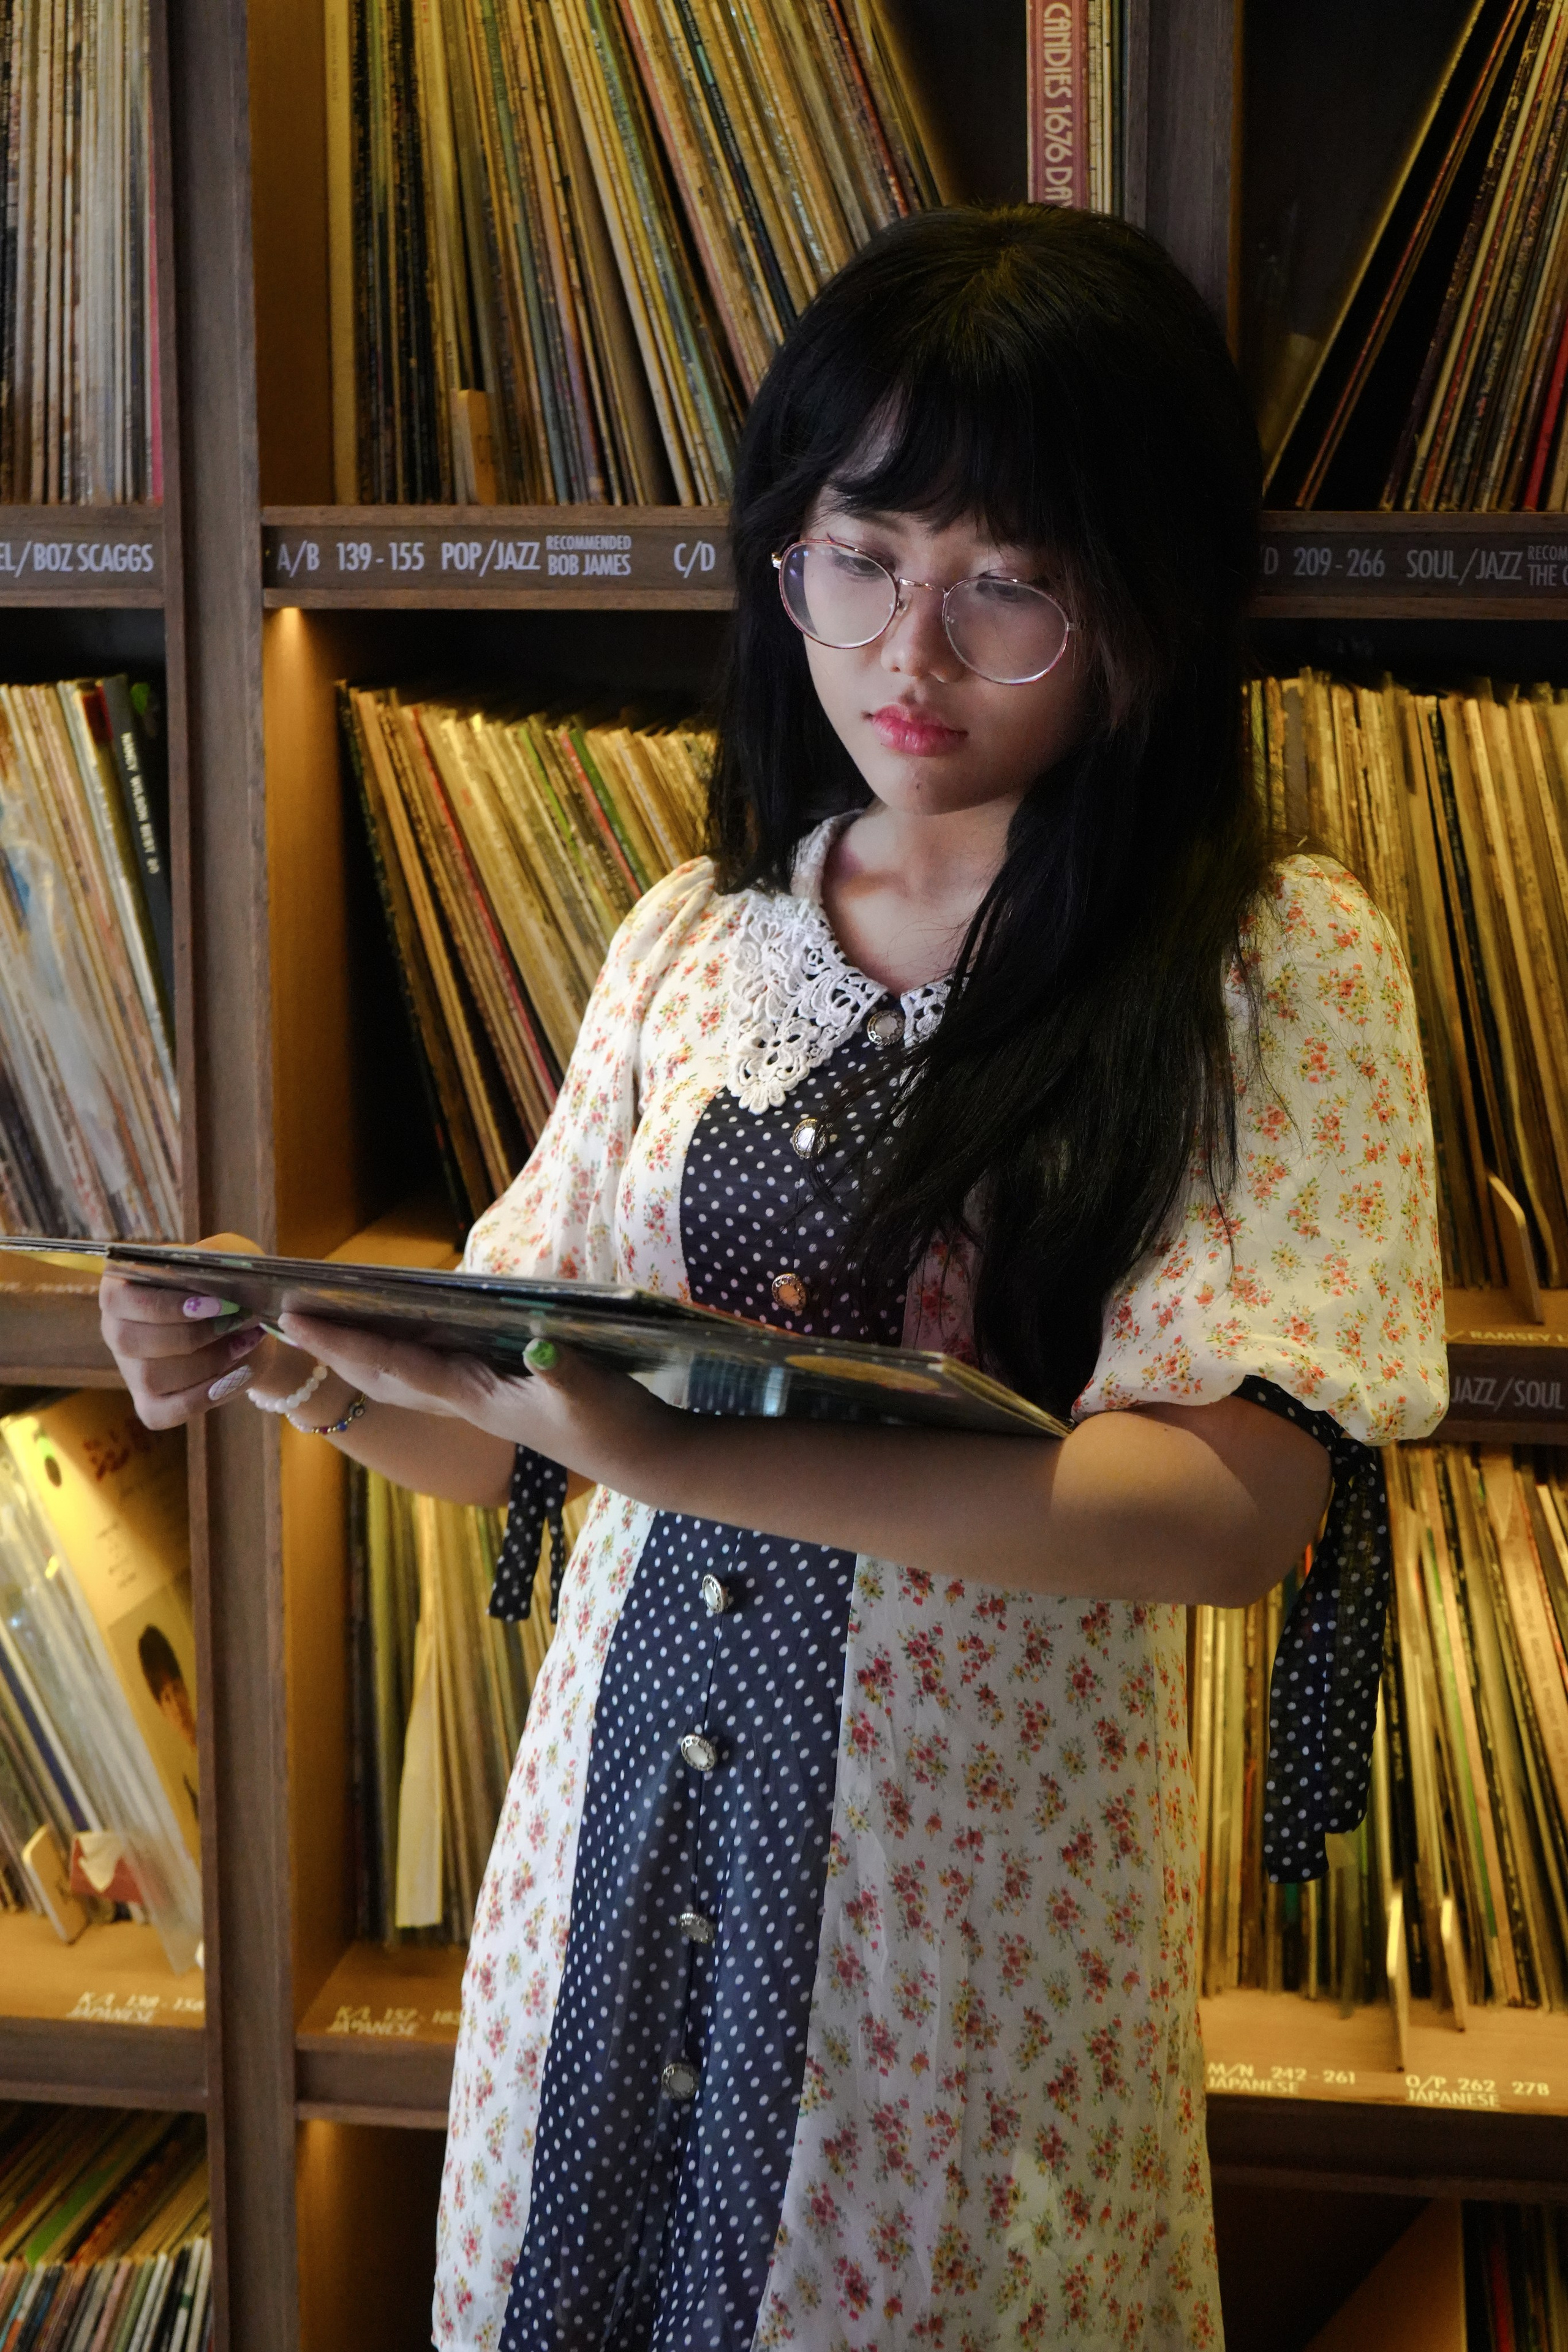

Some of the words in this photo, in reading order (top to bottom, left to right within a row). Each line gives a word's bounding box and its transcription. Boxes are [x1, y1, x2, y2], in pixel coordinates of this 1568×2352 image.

[76, 543, 154, 573] SCAGGS
[276, 539, 320, 578] A/B
[440, 539, 541, 578] POP/JAZZ
[546, 534, 632, 551] RECOMMENDED
[547, 554, 579, 576] BOB
[581, 554, 632, 576] JAMES
[673, 540, 716, 579] C/D
[1406, 548, 1523, 586] SOUL/JAZZ
[1526, 564, 1558, 587] THE
[1450, 1376, 1566, 1412] JAZZ/SOUL
